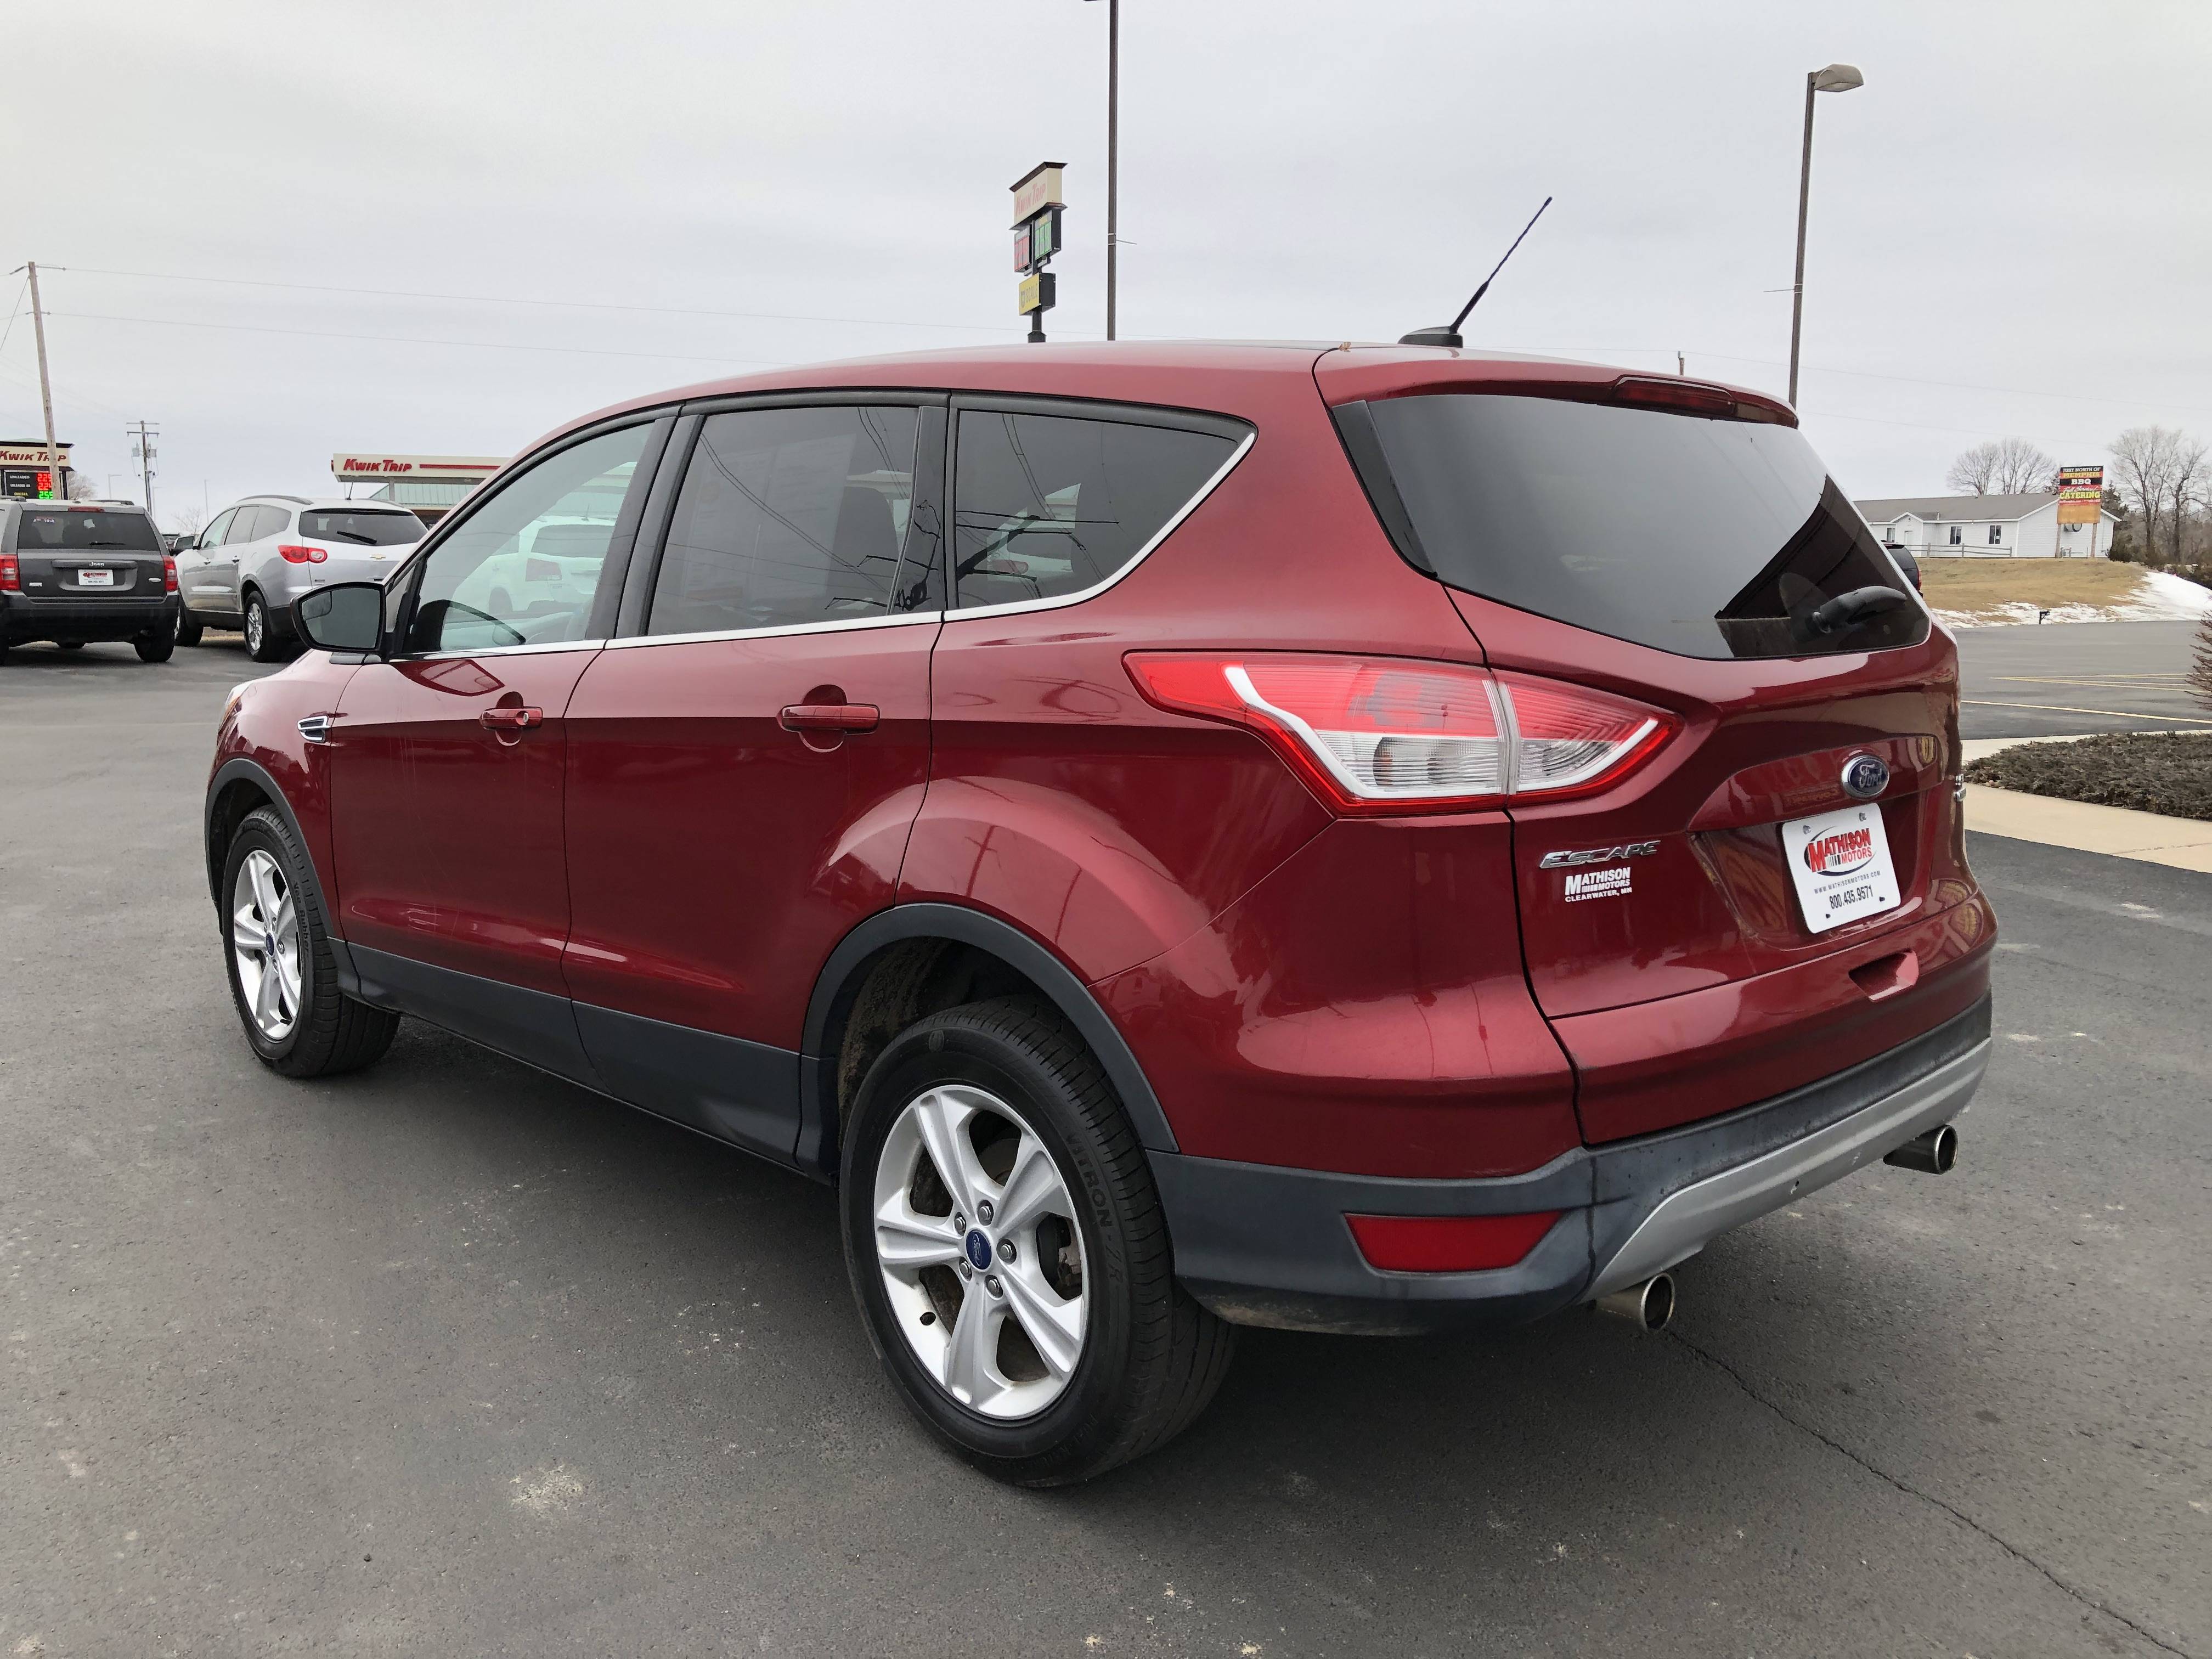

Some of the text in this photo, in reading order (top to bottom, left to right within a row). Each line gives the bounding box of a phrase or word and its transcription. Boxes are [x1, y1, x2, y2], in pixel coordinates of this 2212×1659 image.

[36, 452, 66, 462] TRP
[343, 459, 413, 472] KWIK TRIP
[1859, 764, 1882, 788] Ford
[1539, 840, 1661, 869] ESCAPE
[1808, 827, 1872, 873] MATHISON
[1841, 847, 1873, 865] MOTORS
[1565, 867, 1631, 896] MATHISON
[1598, 879, 1630, 891] MOTORS
[1565, 889, 1620, 902] CLEARWATER,
[1829, 884, 1874, 910] 800.435.9571
